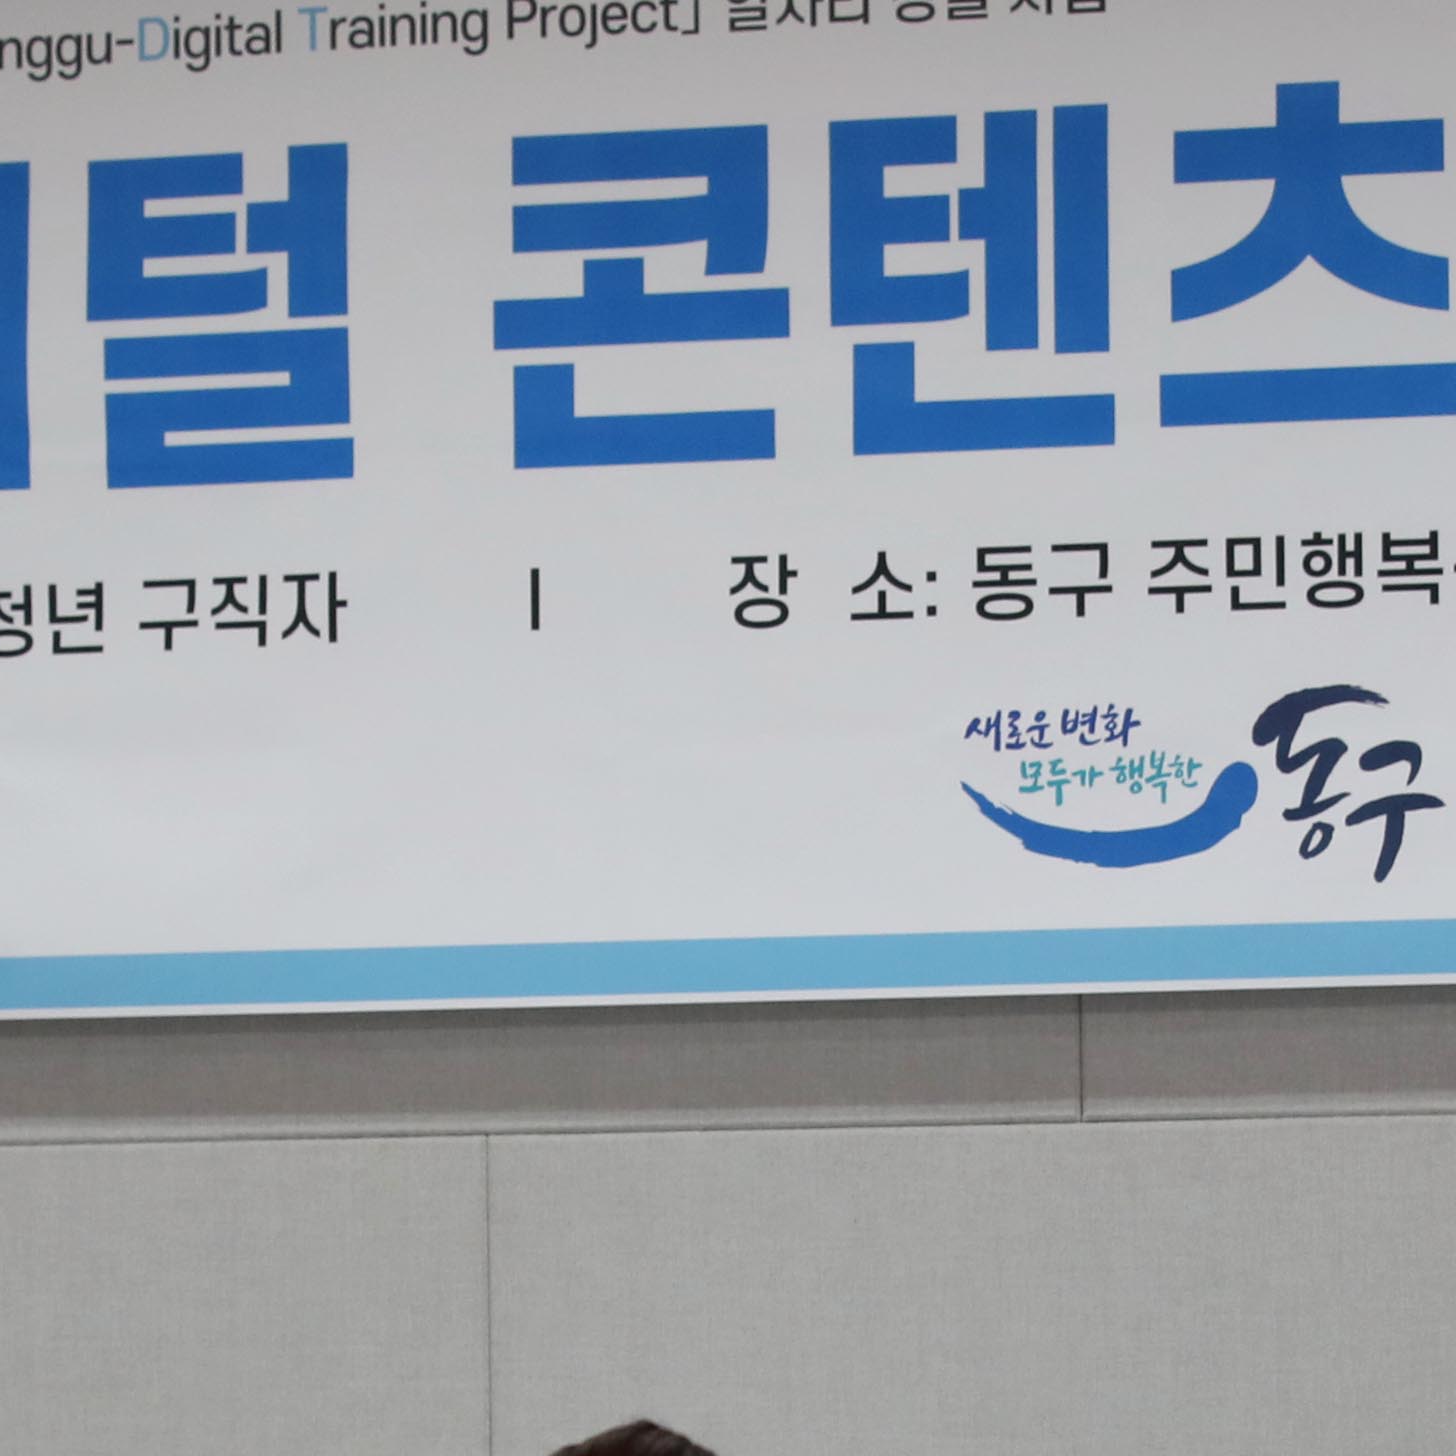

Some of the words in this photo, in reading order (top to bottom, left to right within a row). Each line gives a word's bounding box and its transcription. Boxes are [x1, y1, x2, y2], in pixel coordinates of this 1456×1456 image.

[299, 1, 488, 55] Training
[139, 571, 348, 651] 구직자
[972, 542, 1113, 621] 동구
[964, 709, 1054, 752] 새로운
[1061, 704, 1141, 747] 변화
[1020, 759, 1103, 805] 모두가
[1111, 752, 1204, 803] 행복한
[1252, 684, 1446, 882] 동구
